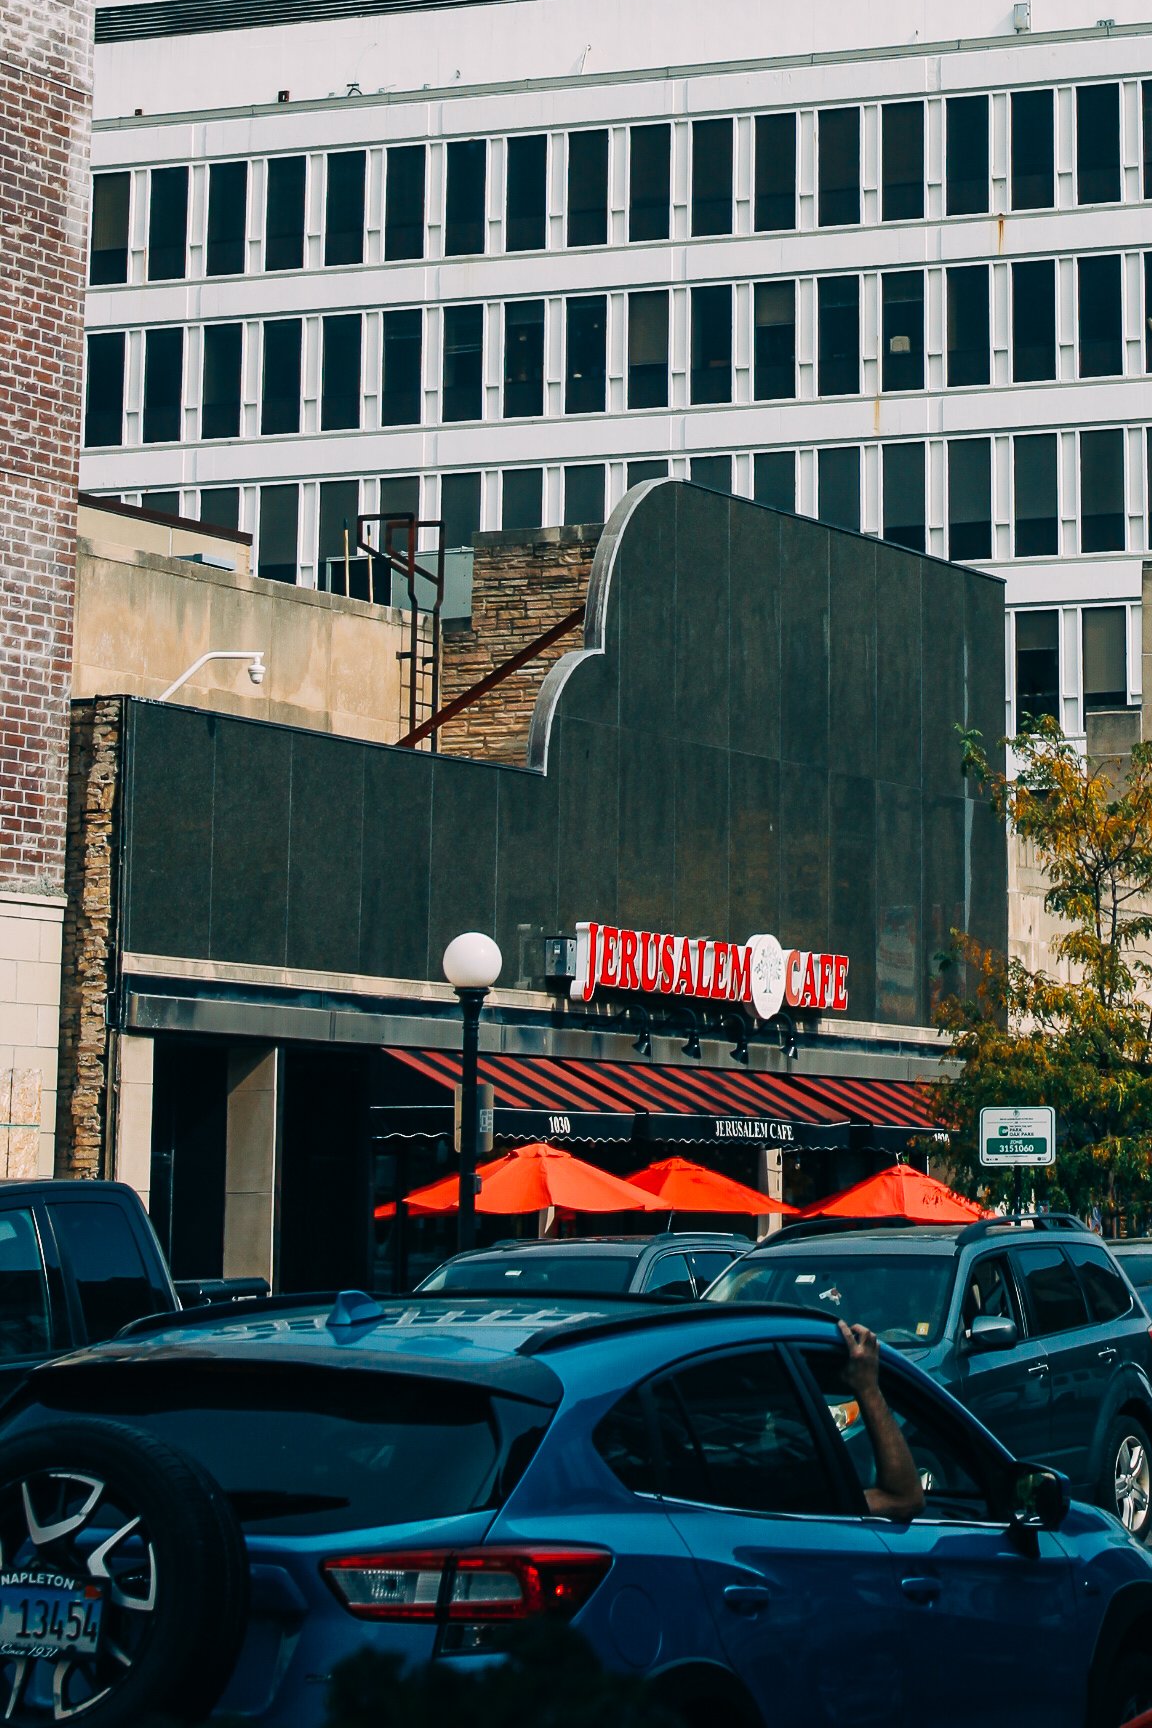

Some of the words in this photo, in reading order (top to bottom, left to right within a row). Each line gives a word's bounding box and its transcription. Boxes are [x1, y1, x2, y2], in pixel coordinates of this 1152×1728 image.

[582, 922, 753, 1002] JERUSALEM
[785, 948, 850, 1011] CAFE
[548, 1115, 572, 1134] 1030
[715, 1119, 768, 1139] JERUSALEM
[769, 1122, 795, 1141] CAFE
[1, 1572, 75, 1591] NAPLETON
[16, 1598, 97, 1643] 13454
[28, 1646, 60, 1658] 1931
